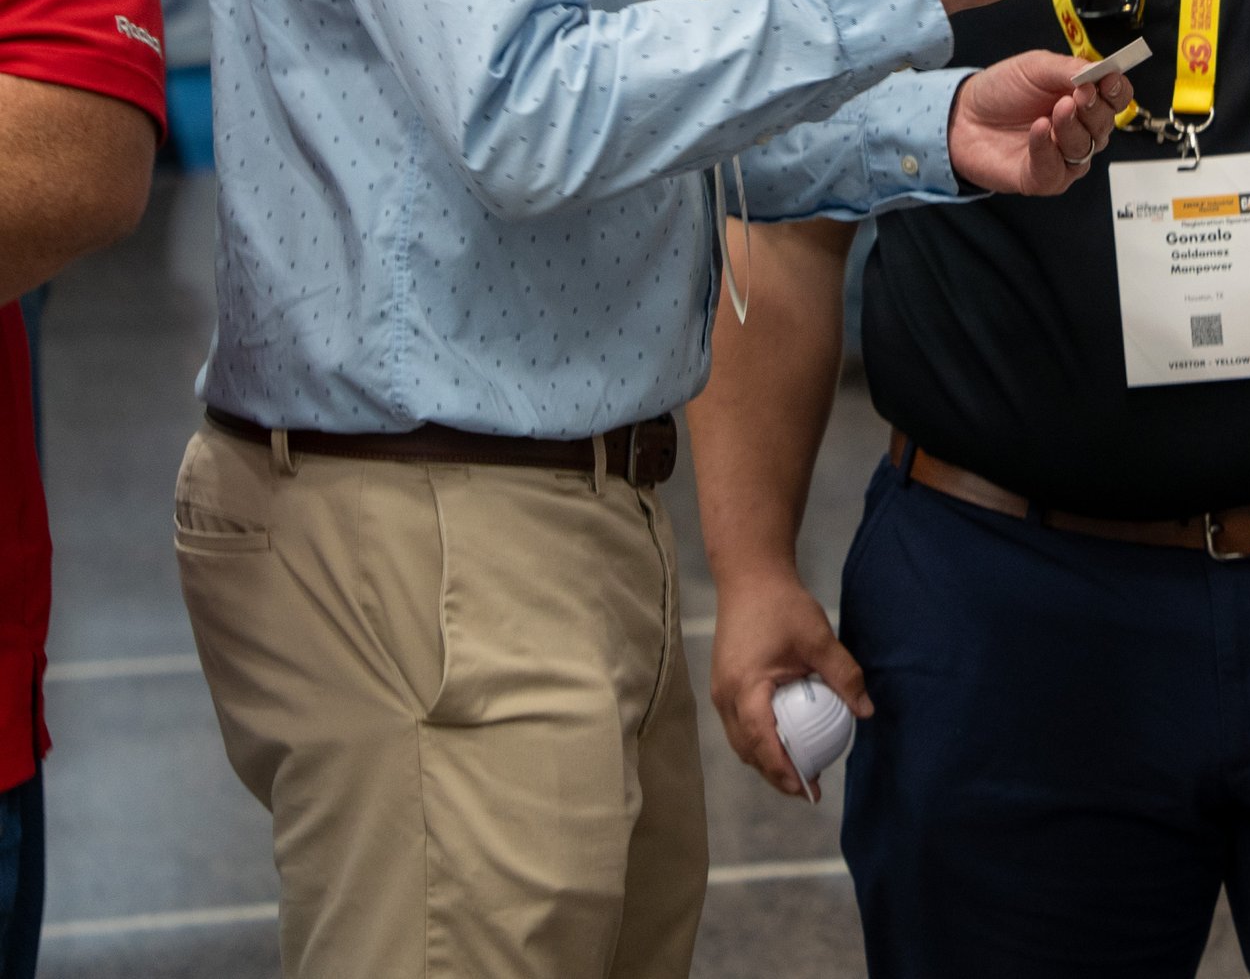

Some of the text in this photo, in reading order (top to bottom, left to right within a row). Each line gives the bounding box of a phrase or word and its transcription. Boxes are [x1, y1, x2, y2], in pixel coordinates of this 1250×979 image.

[1189, 44, 1210, 75] 3S
[1165, 228, 1232, 246] Gonzalo
[1170, 261, 1233, 276] Manpower
[1168, 359, 1206, 370] VISITOR
[1214, 356, 1250, 368] YELLOW
